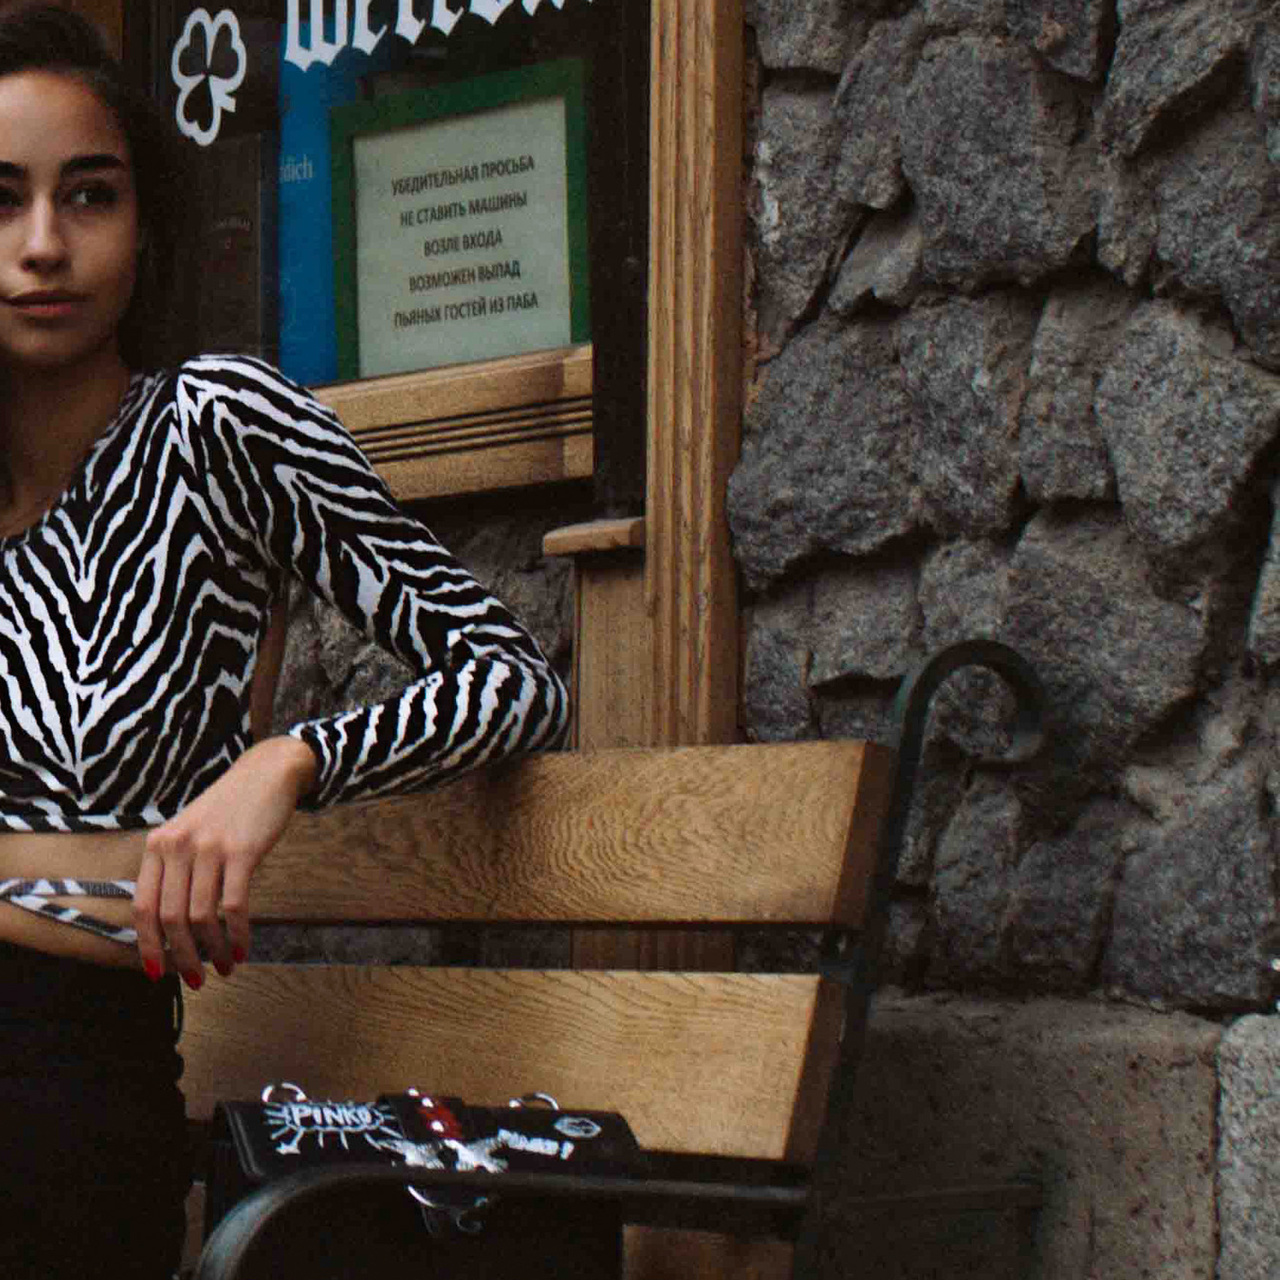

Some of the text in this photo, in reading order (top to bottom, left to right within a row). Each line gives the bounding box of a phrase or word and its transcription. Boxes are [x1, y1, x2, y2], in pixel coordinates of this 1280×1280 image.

[391, 154, 535, 196] УБЕДИТЕЛЬНАЯ ПРОСЬБА
[400, 191, 528, 227] НЕ СТАВИТЬ МАШИНЫ
[423, 228, 502, 257] ВОЗЛЕ ВХОДА
[409, 259, 521, 294] ВОЗМОЖЕН ВЫПАД
[394, 291, 539, 328] ПЬЯНЫХ ГОСТЕЙ ИЗ ПАБА
